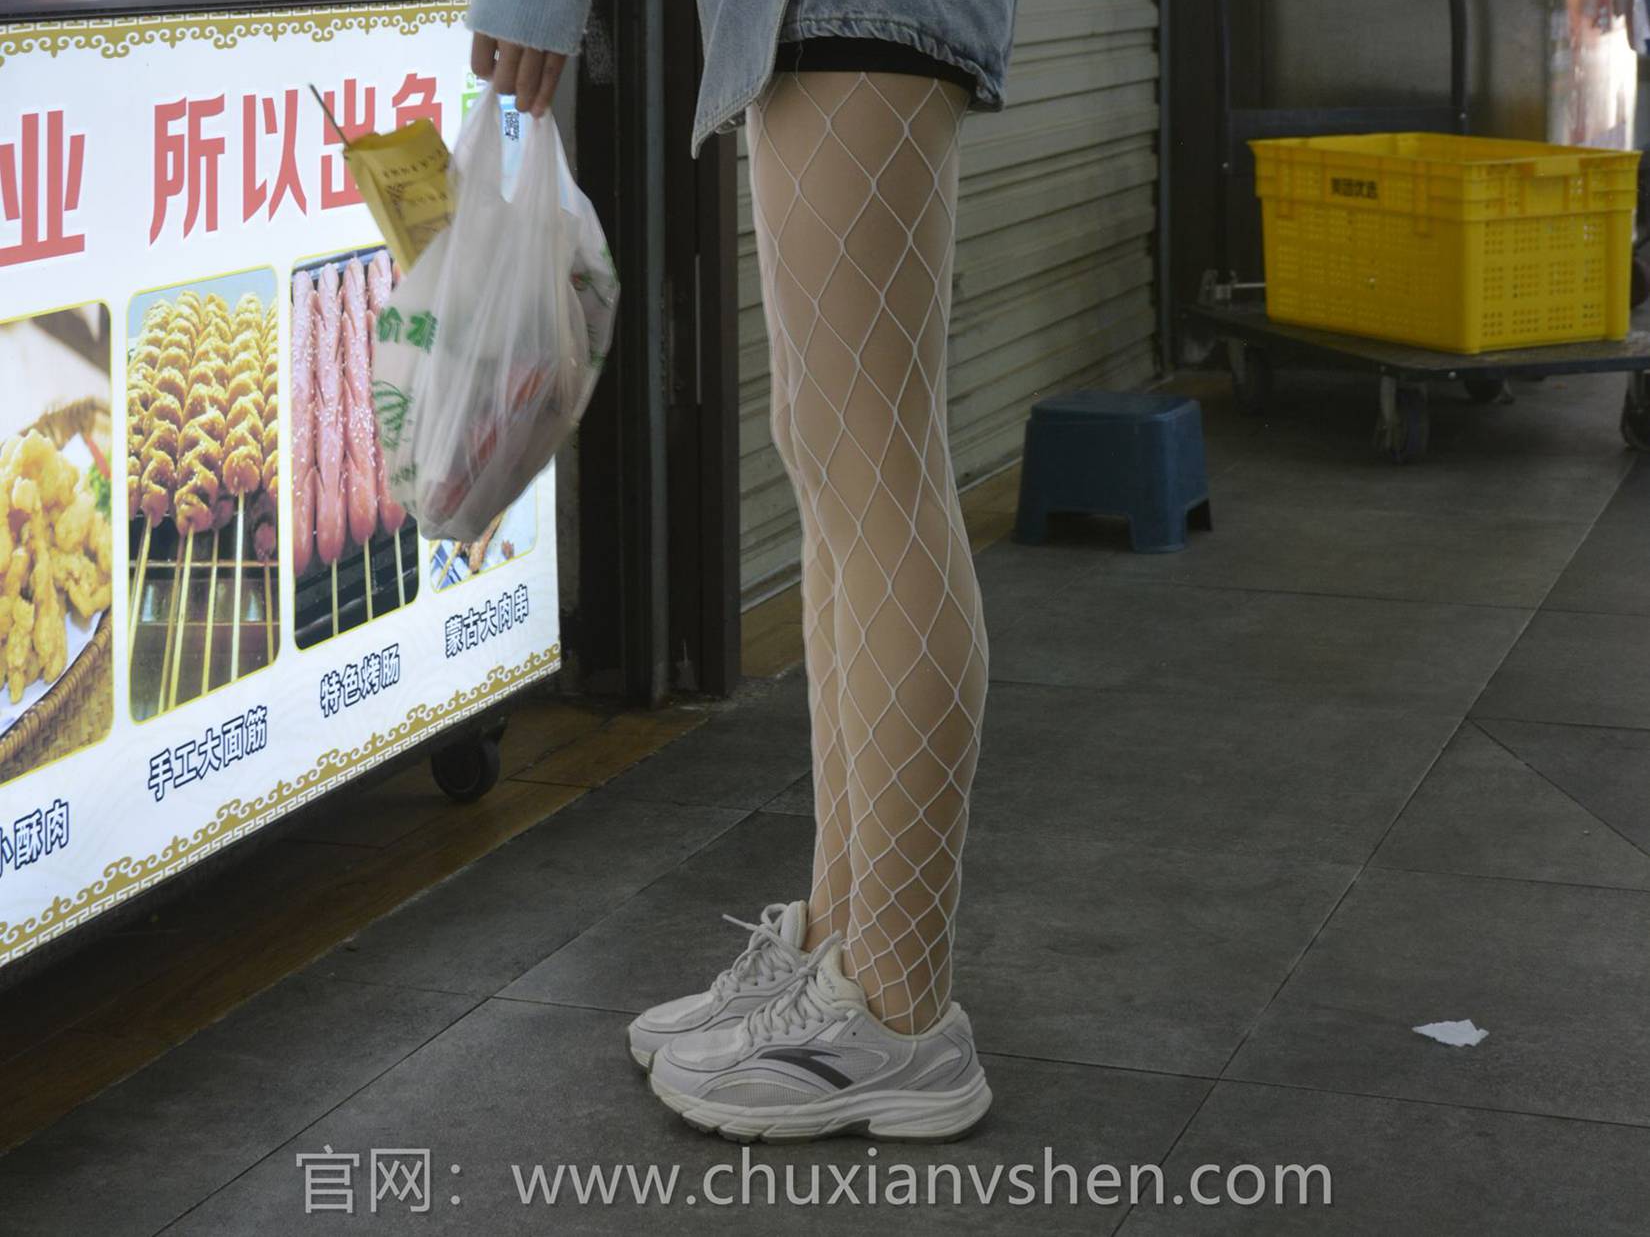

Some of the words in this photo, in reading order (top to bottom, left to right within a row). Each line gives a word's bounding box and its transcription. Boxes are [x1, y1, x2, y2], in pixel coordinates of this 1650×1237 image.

[444, 583, 529, 659] 蒙古大肉串
[319, 642, 400, 718] 特色烤肠
[147, 705, 268, 802] 手工大面筋
